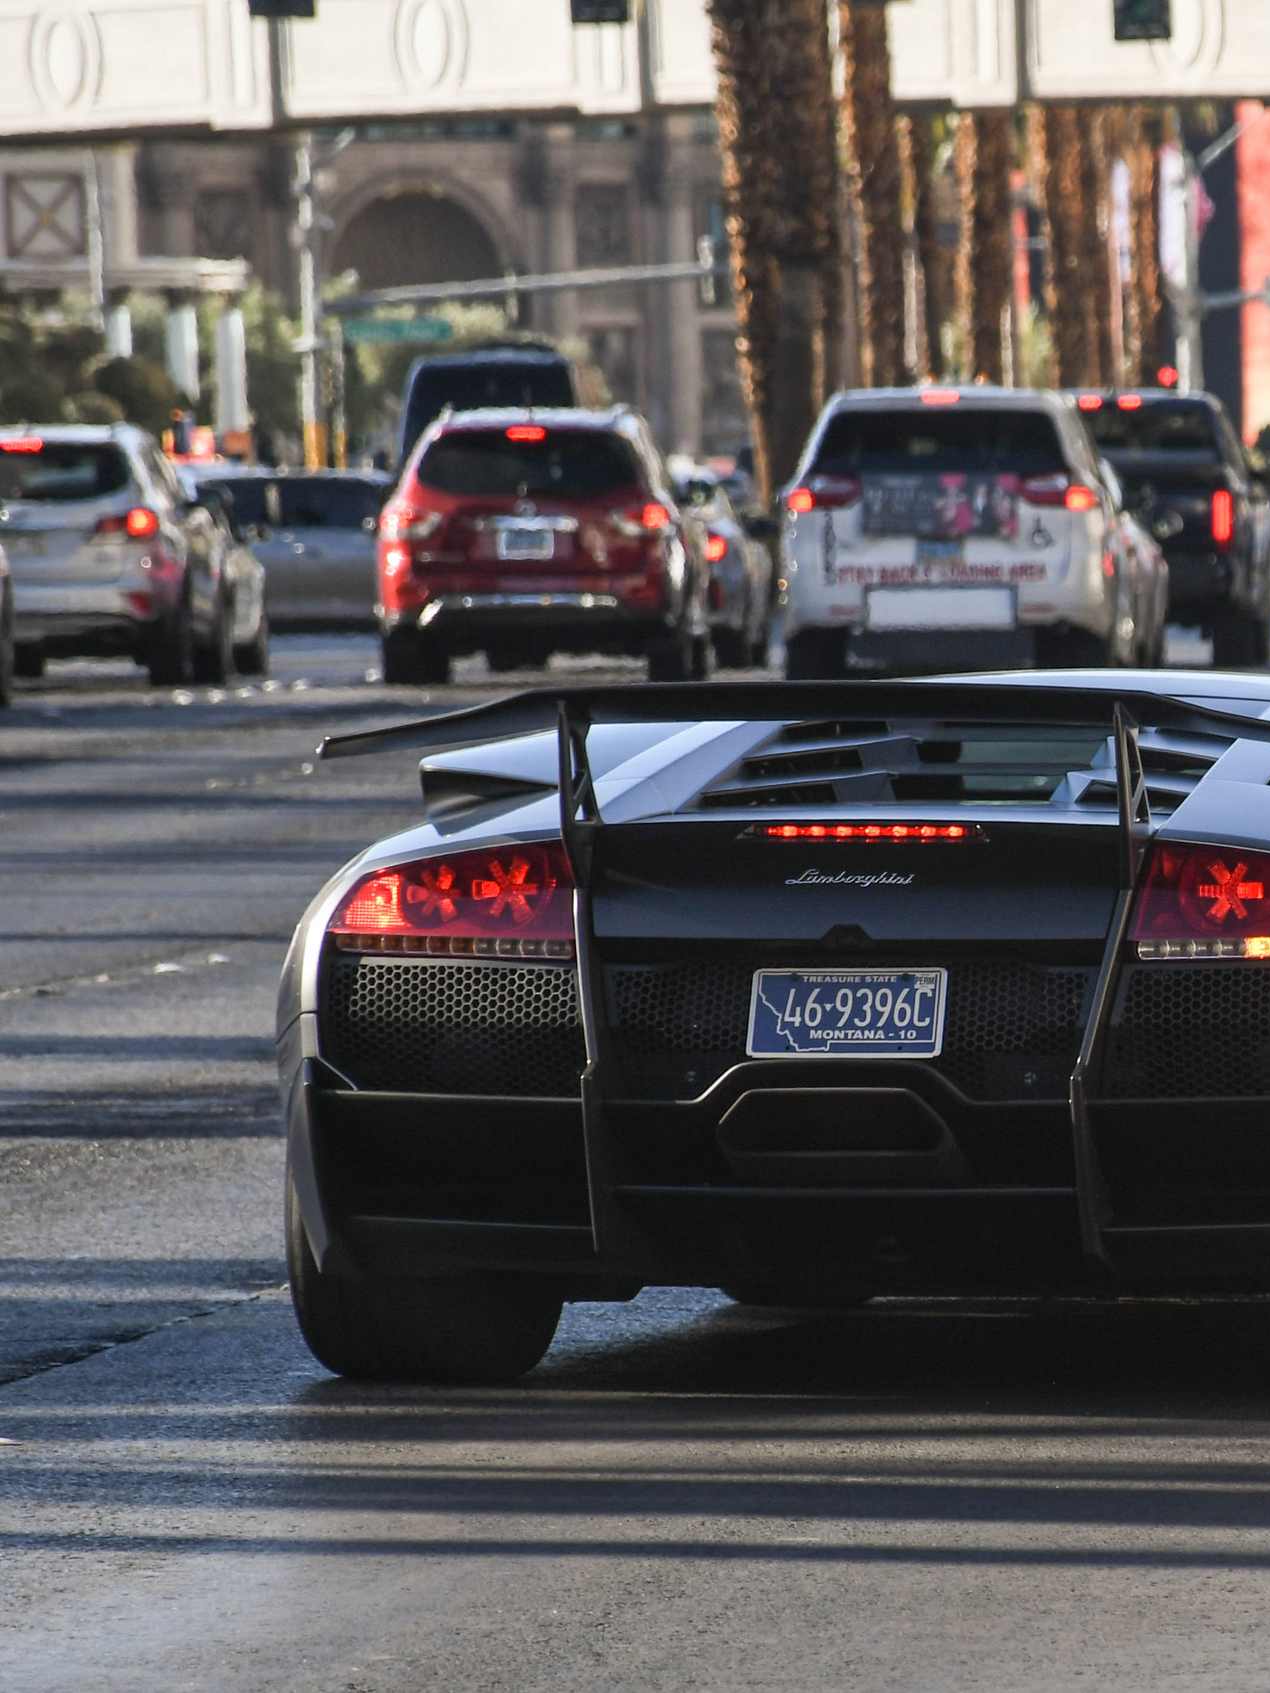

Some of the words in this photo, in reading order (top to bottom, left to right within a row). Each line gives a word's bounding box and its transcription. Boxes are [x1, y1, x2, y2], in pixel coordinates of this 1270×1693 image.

[785, 868, 916, 888] Lamborghini
[802, 975, 861, 984] TREASURE
[865, 975, 897, 984] STATE
[809, 1030, 885, 1040] MONTANA
[898, 1030, 917, 1040] 10
